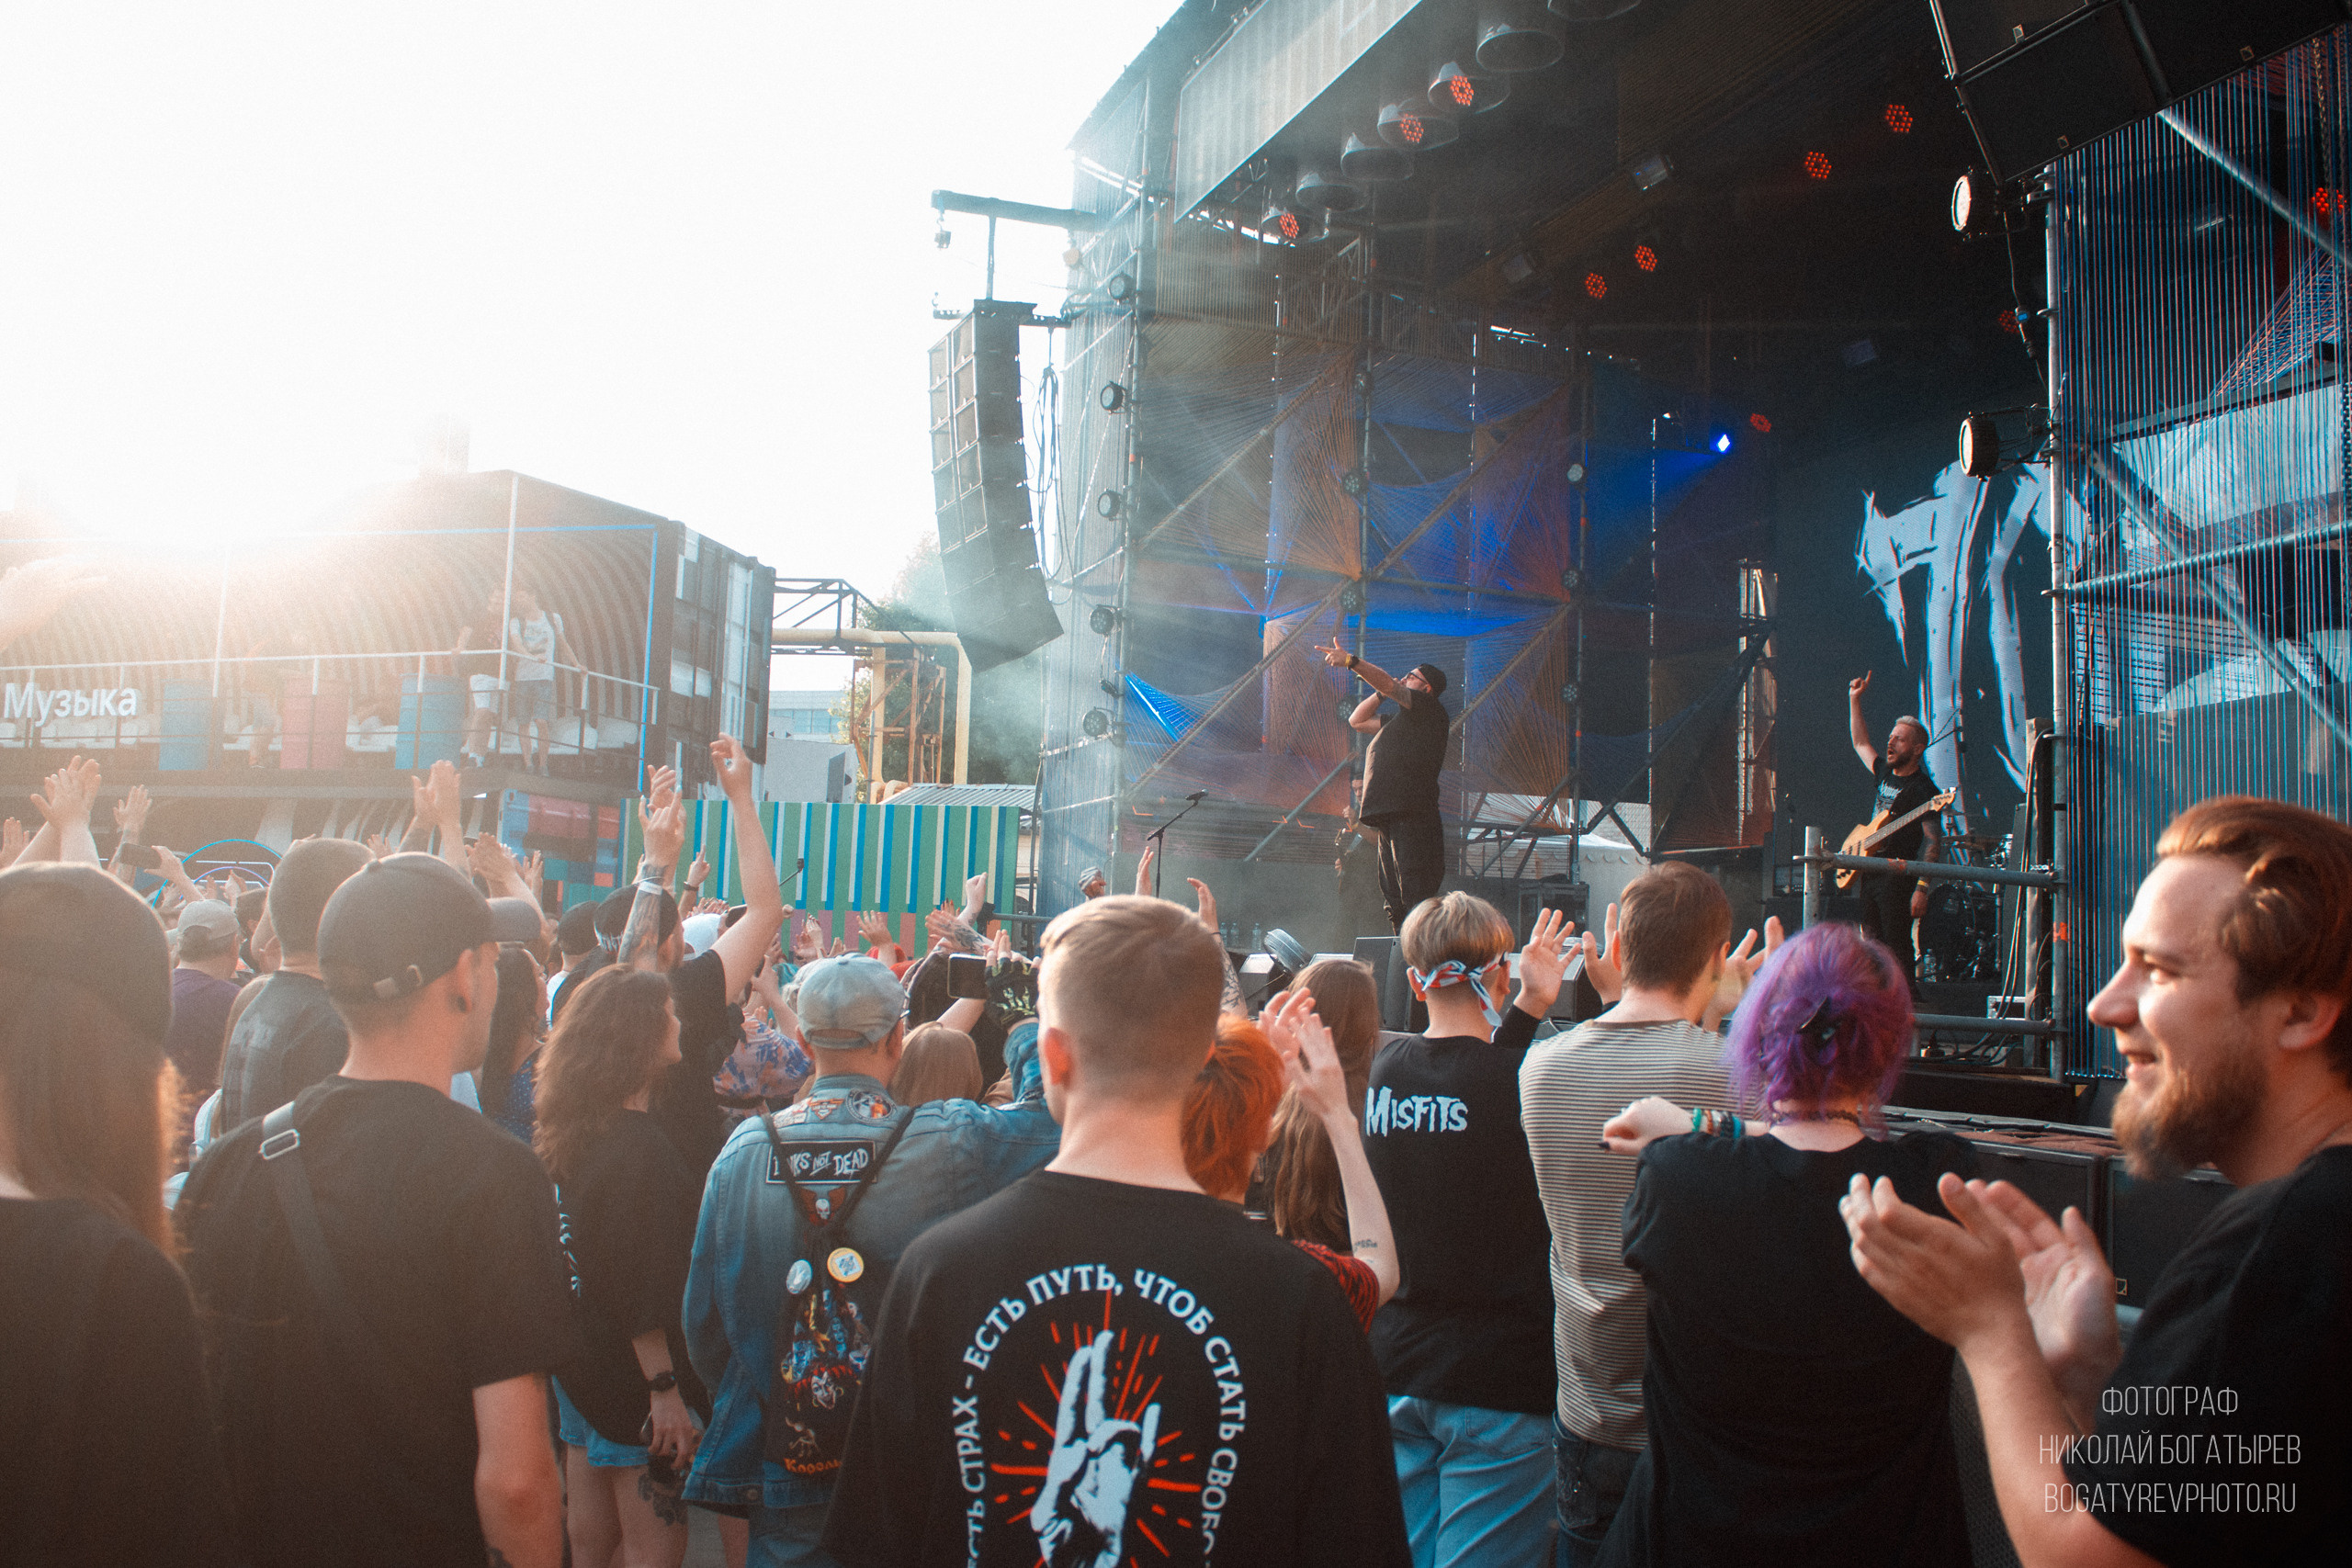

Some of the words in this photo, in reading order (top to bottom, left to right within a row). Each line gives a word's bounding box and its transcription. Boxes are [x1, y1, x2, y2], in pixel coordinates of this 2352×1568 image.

[4, 682, 138, 728] Музыка
[812, 1151, 831, 1171] NOT
[832, 1148, 869, 1177] DEAD
[1025, 1263, 1124, 1306] ПУТЬ,
[1134, 1268, 1215, 1335] ЧТОБ
[963, 1296, 1027, 1371] ЕСТЬ
[1204, 1336, 1246, 1441] СТАТЬ
[953, 1395, 986, 1494] СТРАХ
